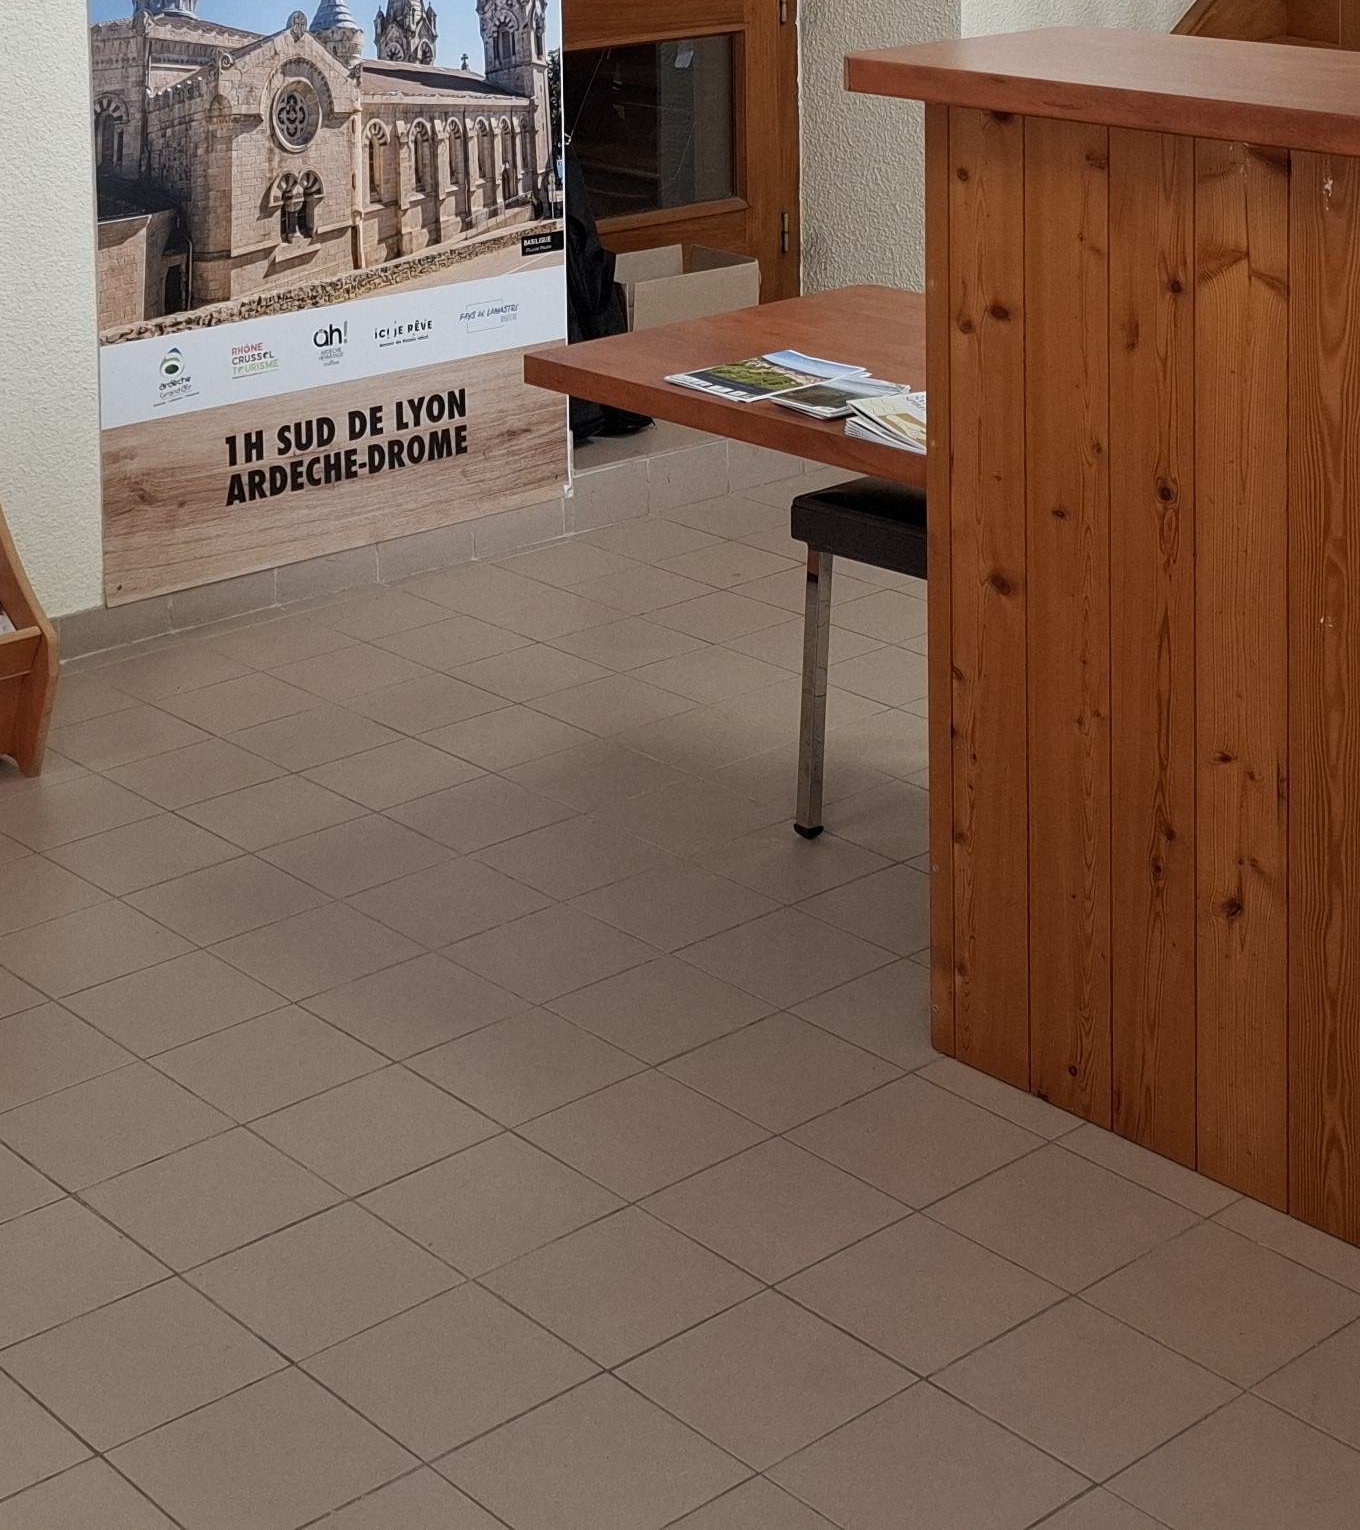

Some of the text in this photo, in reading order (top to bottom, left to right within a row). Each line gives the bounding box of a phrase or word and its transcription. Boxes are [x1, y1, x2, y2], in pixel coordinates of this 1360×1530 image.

[486, 304, 519, 317] LAMASTRE
[231, 342, 264, 357] RHÔNE
[231, 350, 275, 366] CRUSSOL
[232, 358, 280, 375] TOURISME
[158, 376, 192, 391] ardèche
[225, 388, 467, 467] 1H SUD DE LYON
[225, 424, 469, 506] ARDECHE-DROME
